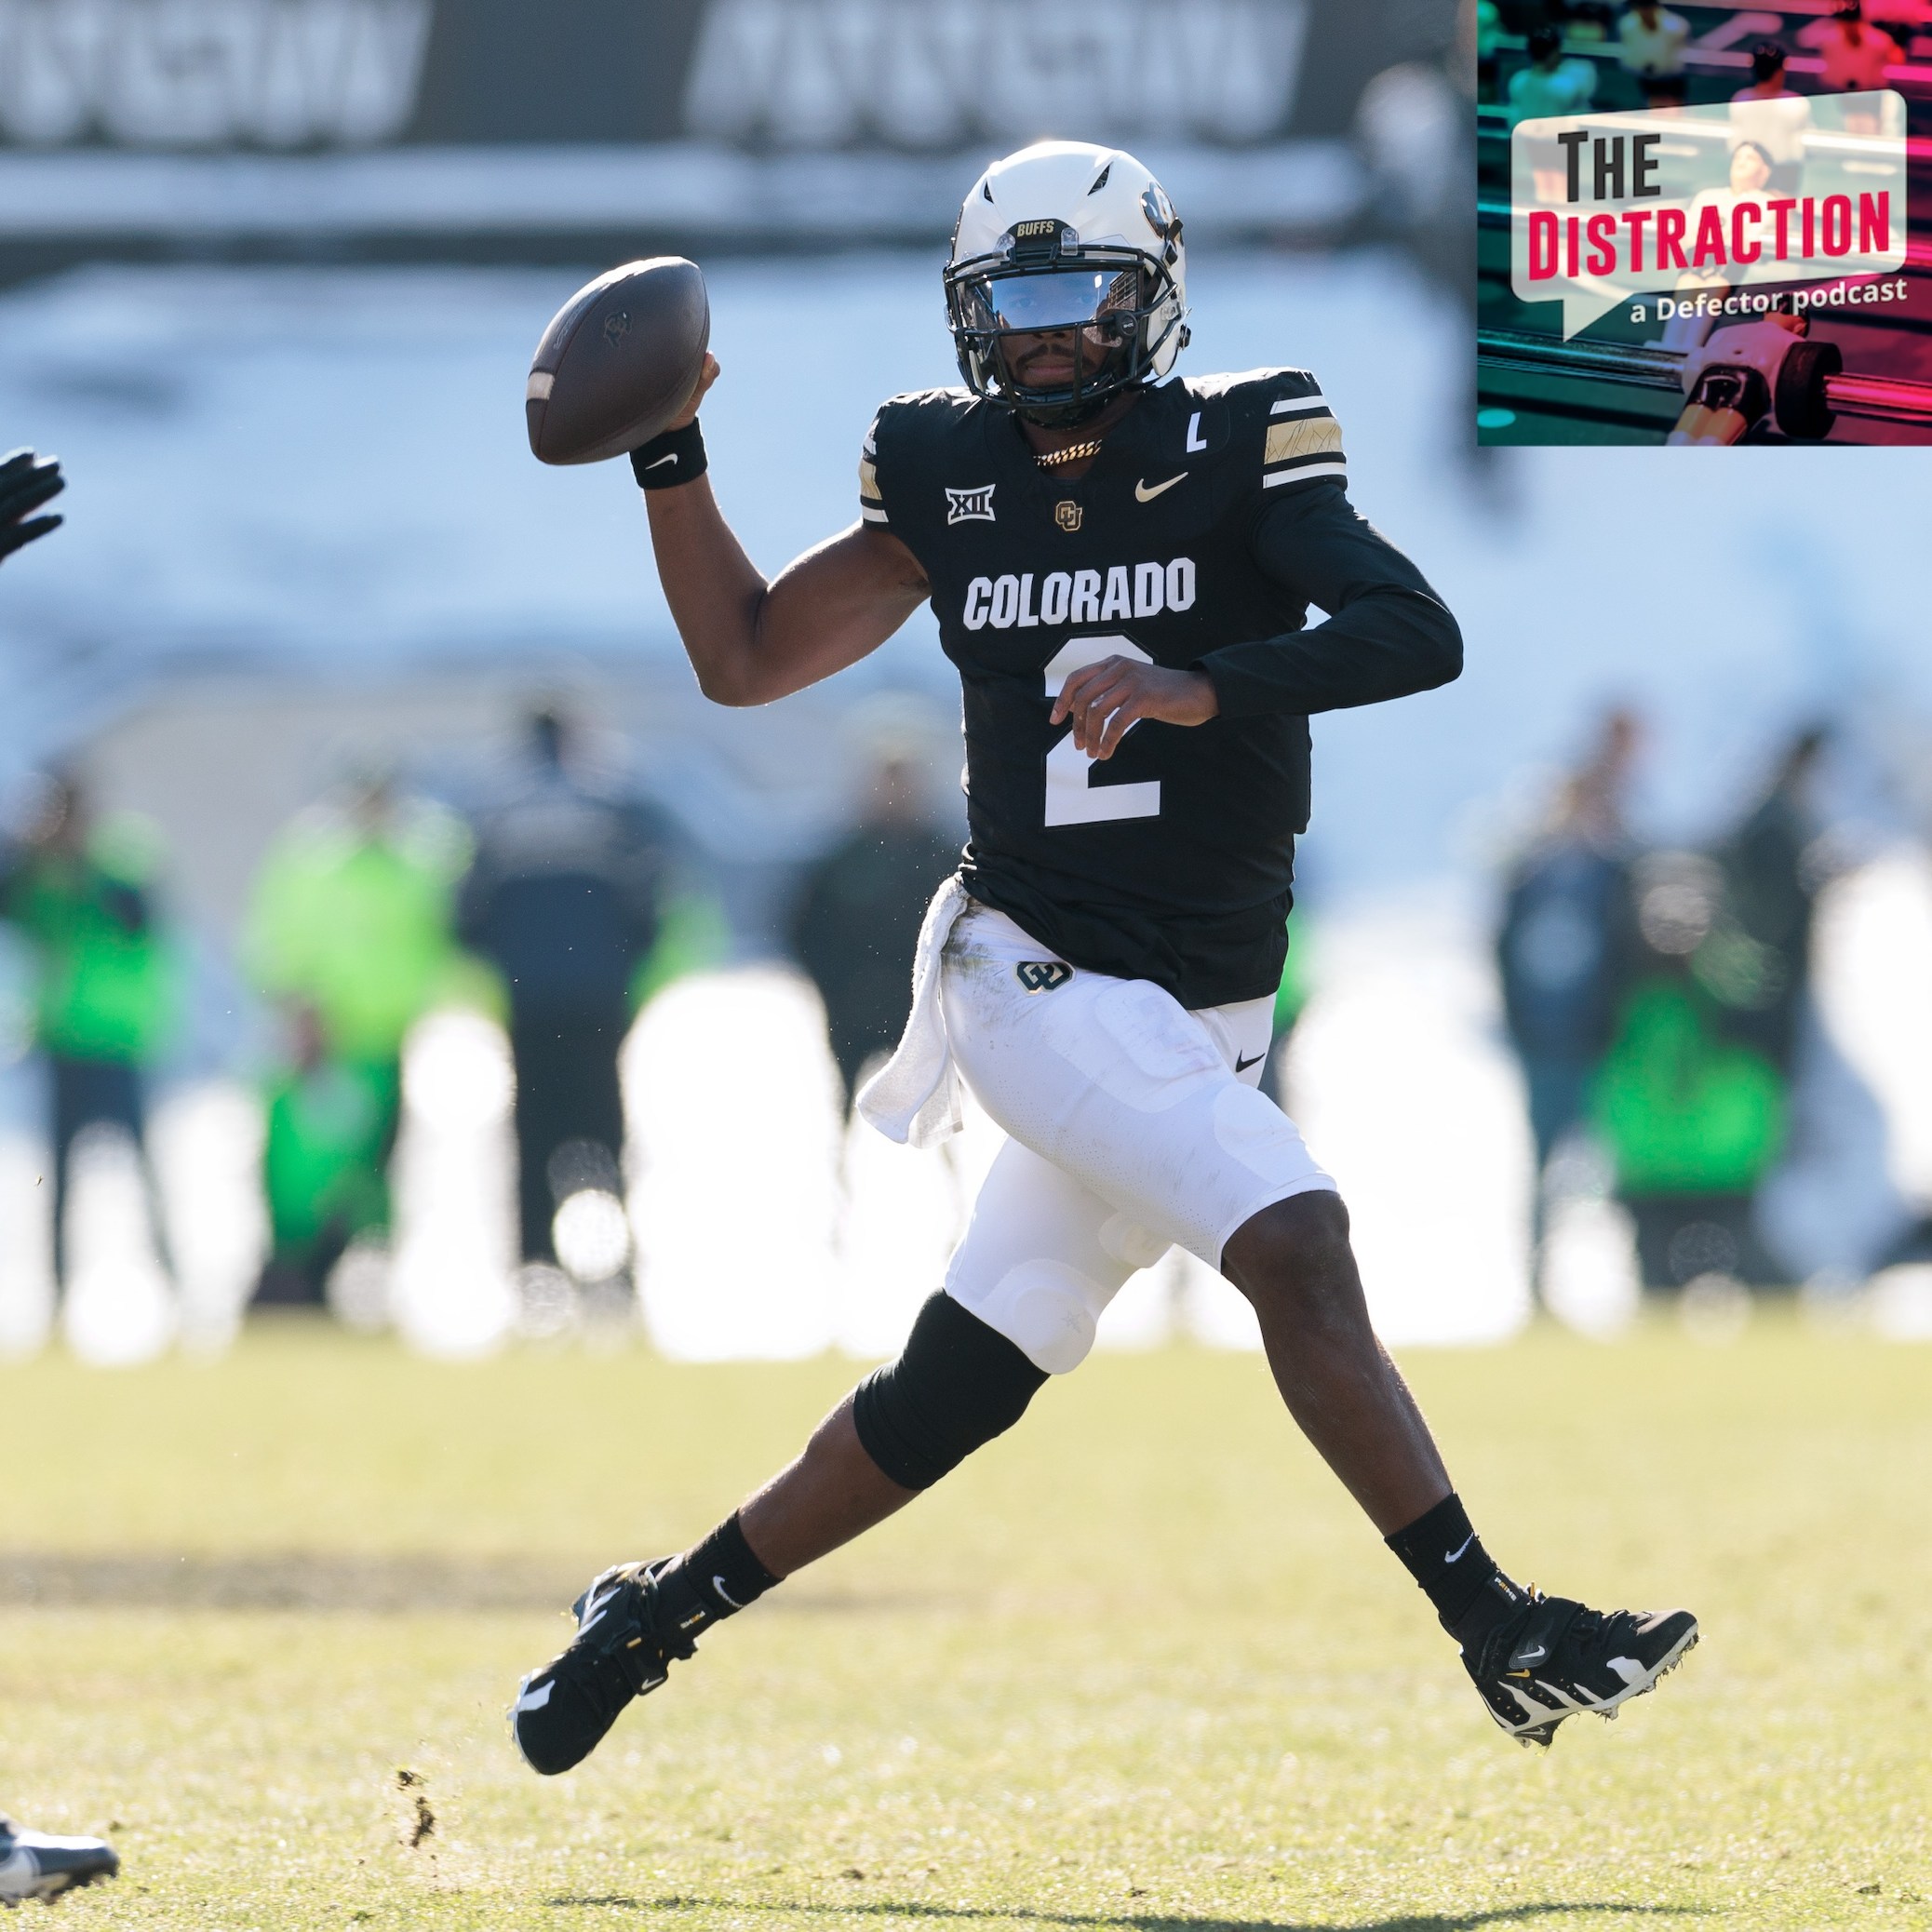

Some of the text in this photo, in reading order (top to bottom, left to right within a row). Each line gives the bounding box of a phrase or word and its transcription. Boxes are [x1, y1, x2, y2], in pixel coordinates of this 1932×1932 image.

[1016, 220, 1055, 237] BUFFS
[946, 485, 995, 523] XII
[962, 557, 1197, 632] COLORADO
[1044, 634, 1161, 827] 2
